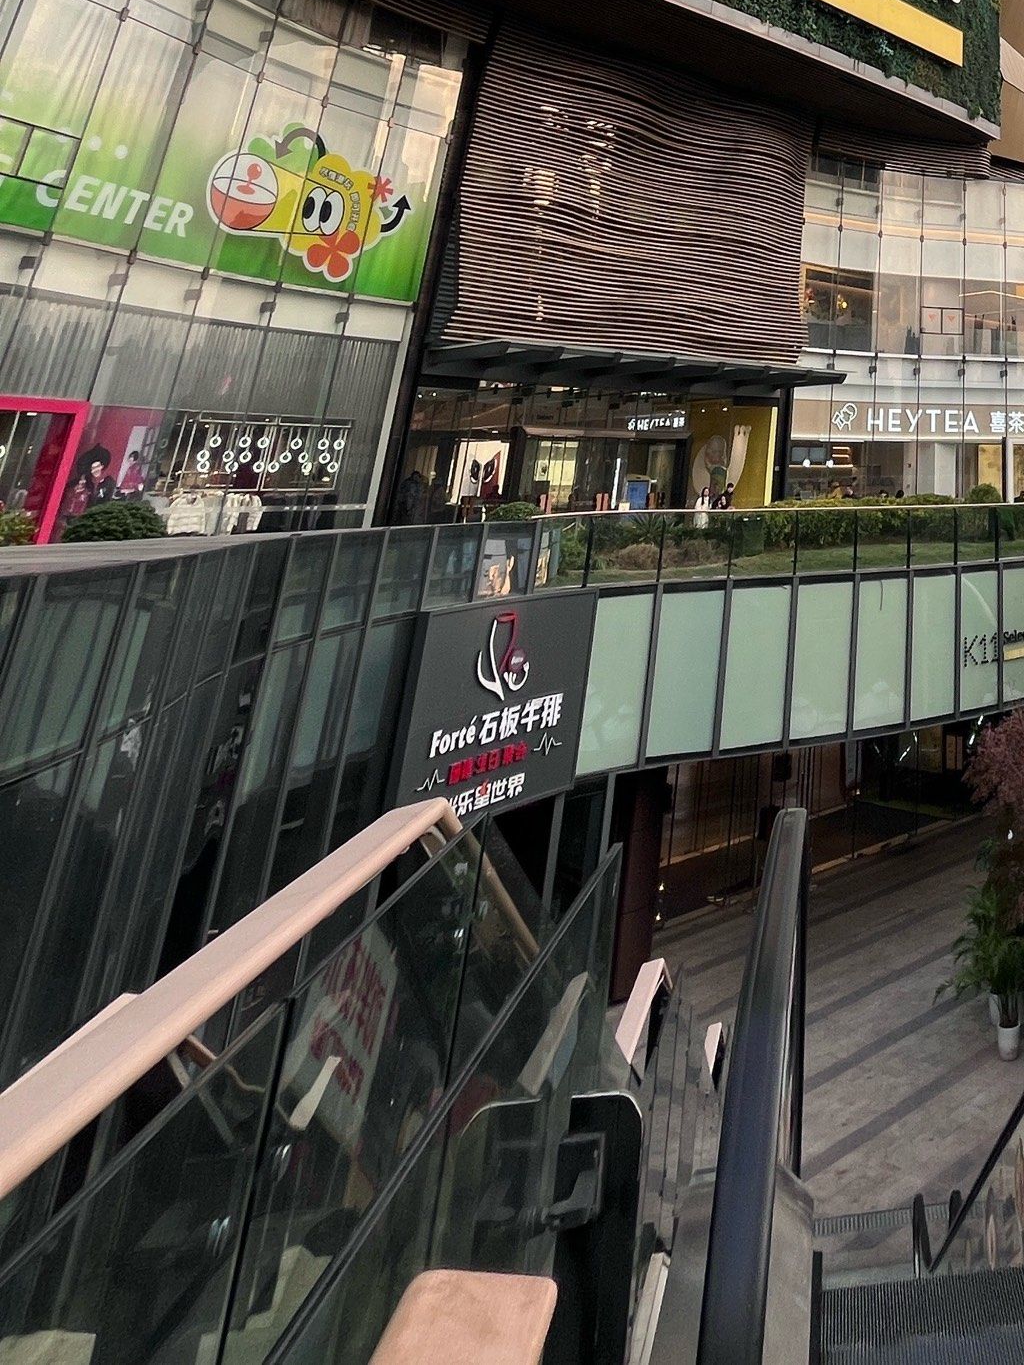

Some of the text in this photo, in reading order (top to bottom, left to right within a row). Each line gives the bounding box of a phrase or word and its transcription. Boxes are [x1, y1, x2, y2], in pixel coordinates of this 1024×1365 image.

[36, 169, 194, 238] CENTER
[867, 407, 980, 434] HEYTEA
[964, 633, 999, 667] K11
[429, 692, 564, 759] Forté 石板牛排
